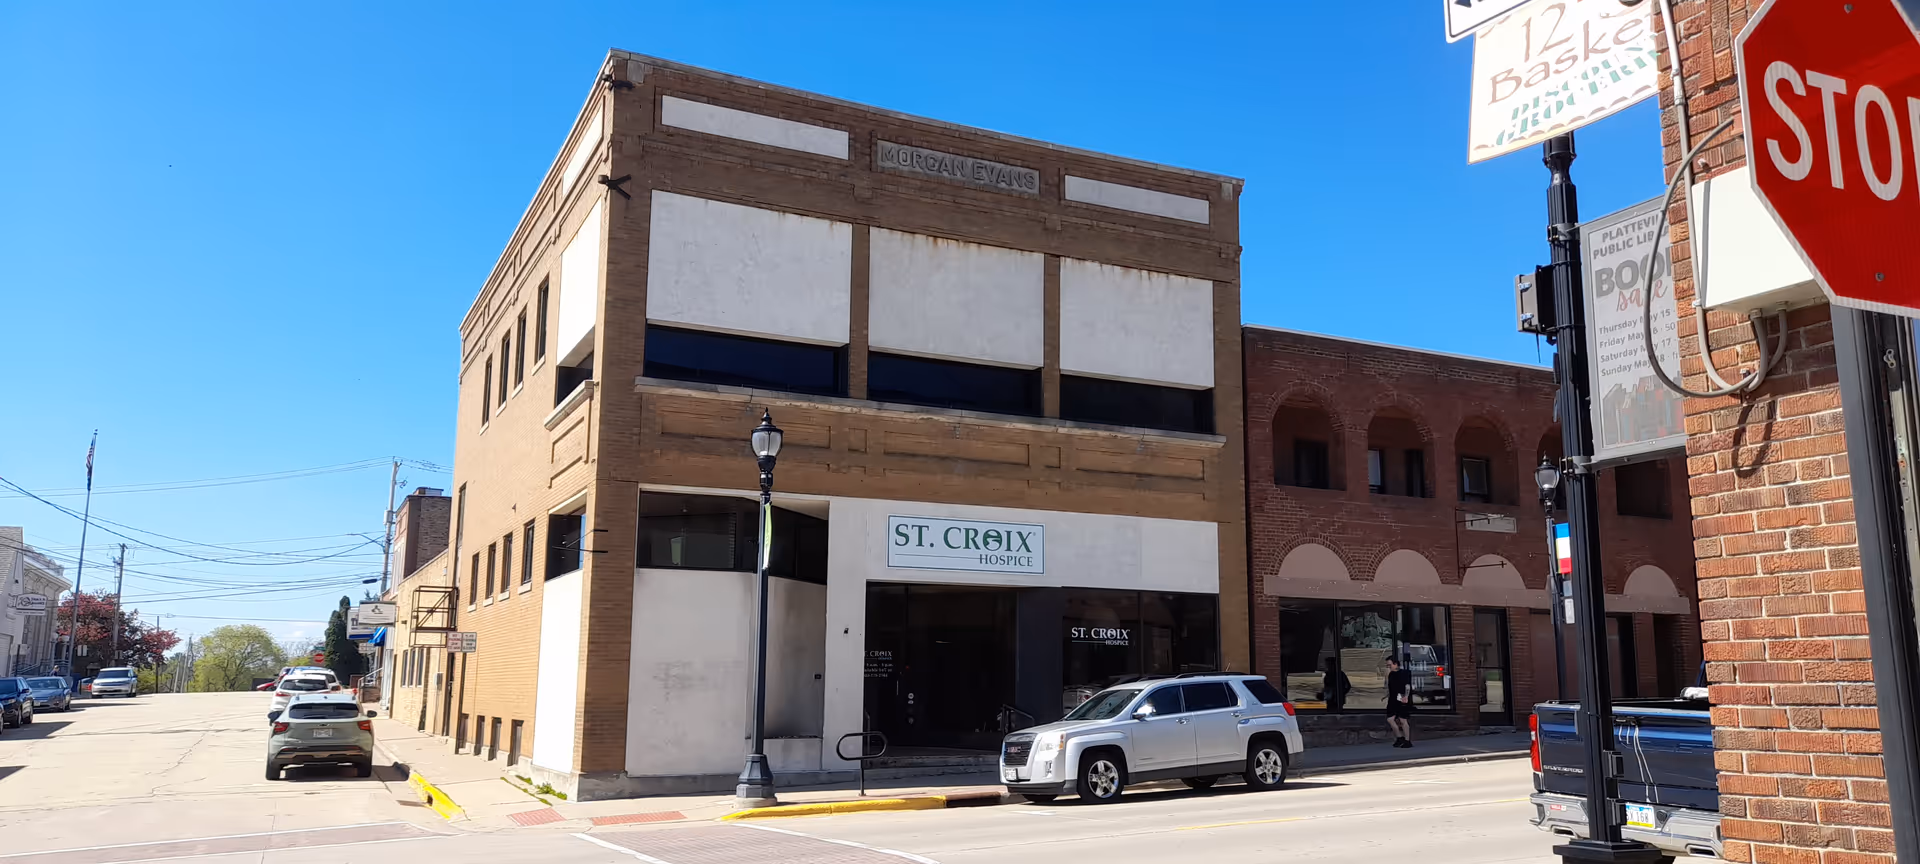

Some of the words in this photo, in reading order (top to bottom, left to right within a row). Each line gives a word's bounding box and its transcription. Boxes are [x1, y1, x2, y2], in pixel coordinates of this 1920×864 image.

[1522, 3, 1574, 62] 12
[880, 145, 966, 177] MORGAN
[972, 160, 1036, 190] EVANS
[1593, 238, 1634, 260] PUBLIC
[1616, 279, 1668, 312] sae
[1599, 318, 1638, 334] Thursday
[1661, 308, 1671, 319] 15
[1600, 336, 1626, 348] Friday
[1600, 347, 1638, 363] Saturday
[1661, 338, 1671, 348] 17
[1601, 363, 1633, 377] Sunday
[894, 523, 934, 548] ST.
[943, 526, 1033, 553] CROIX
[980, 553, 1033, 567] HOSPICE
[1071, 627, 1089, 638] ST.
[1091, 627, 1129, 640] CROIX
